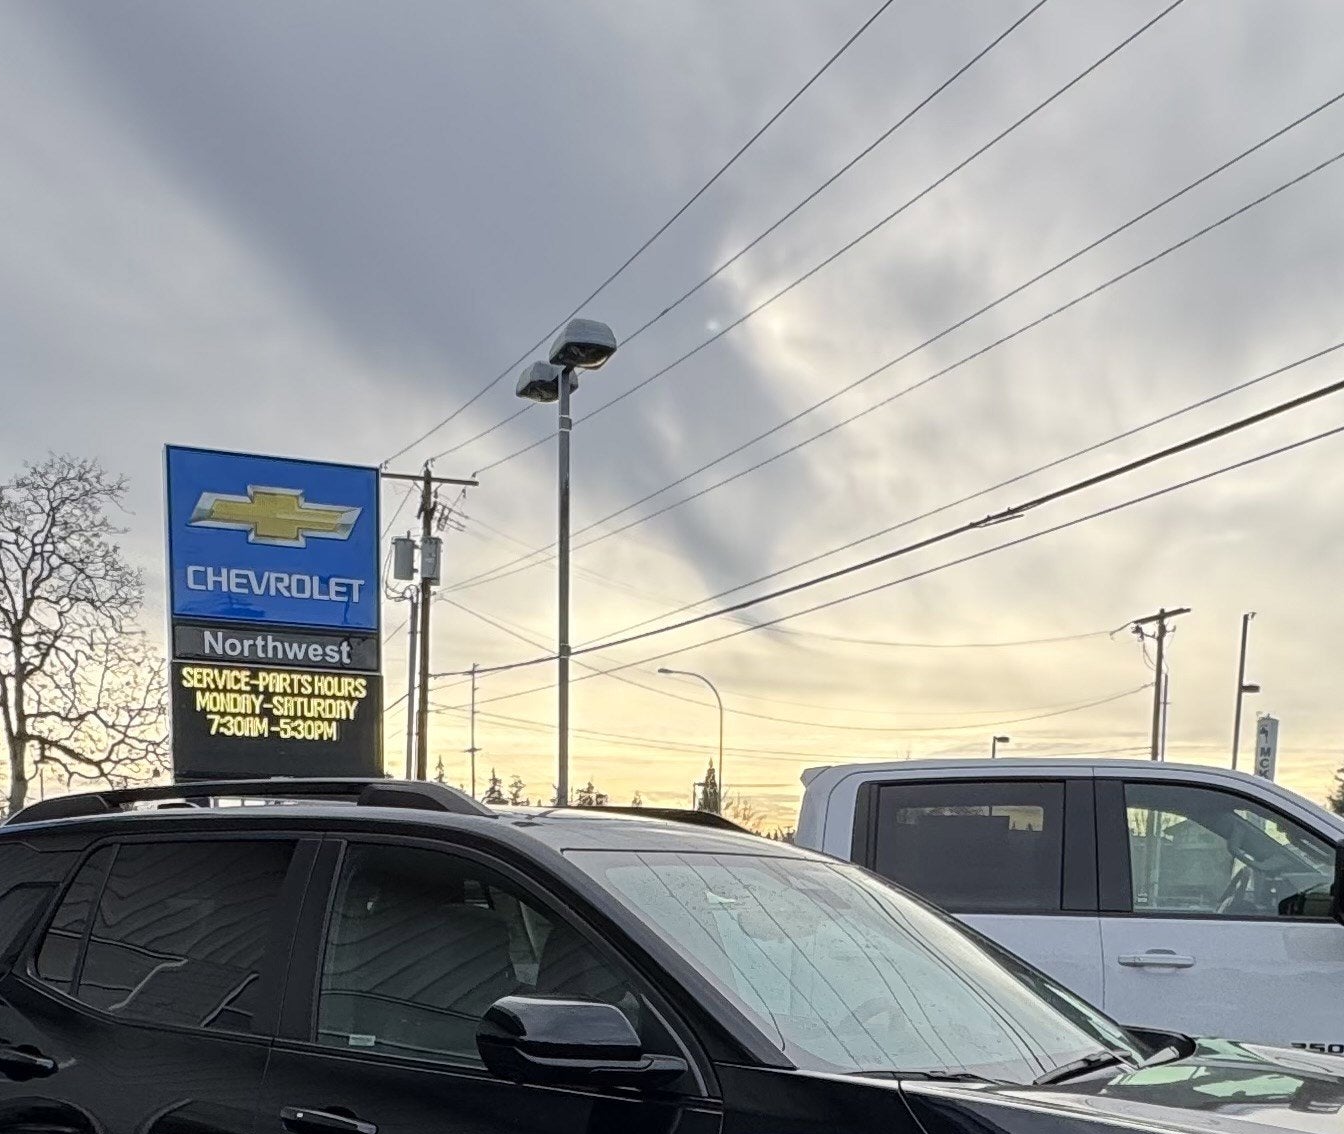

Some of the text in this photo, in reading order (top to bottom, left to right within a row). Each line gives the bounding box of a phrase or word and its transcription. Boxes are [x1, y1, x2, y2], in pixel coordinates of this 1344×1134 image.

[186, 565, 365, 603] CHEVROLET
[203, 631, 352, 664] Northwest
[314, 675, 368, 699] HOURS
[195, 690, 358, 721] MONDAY-SATURDAY
